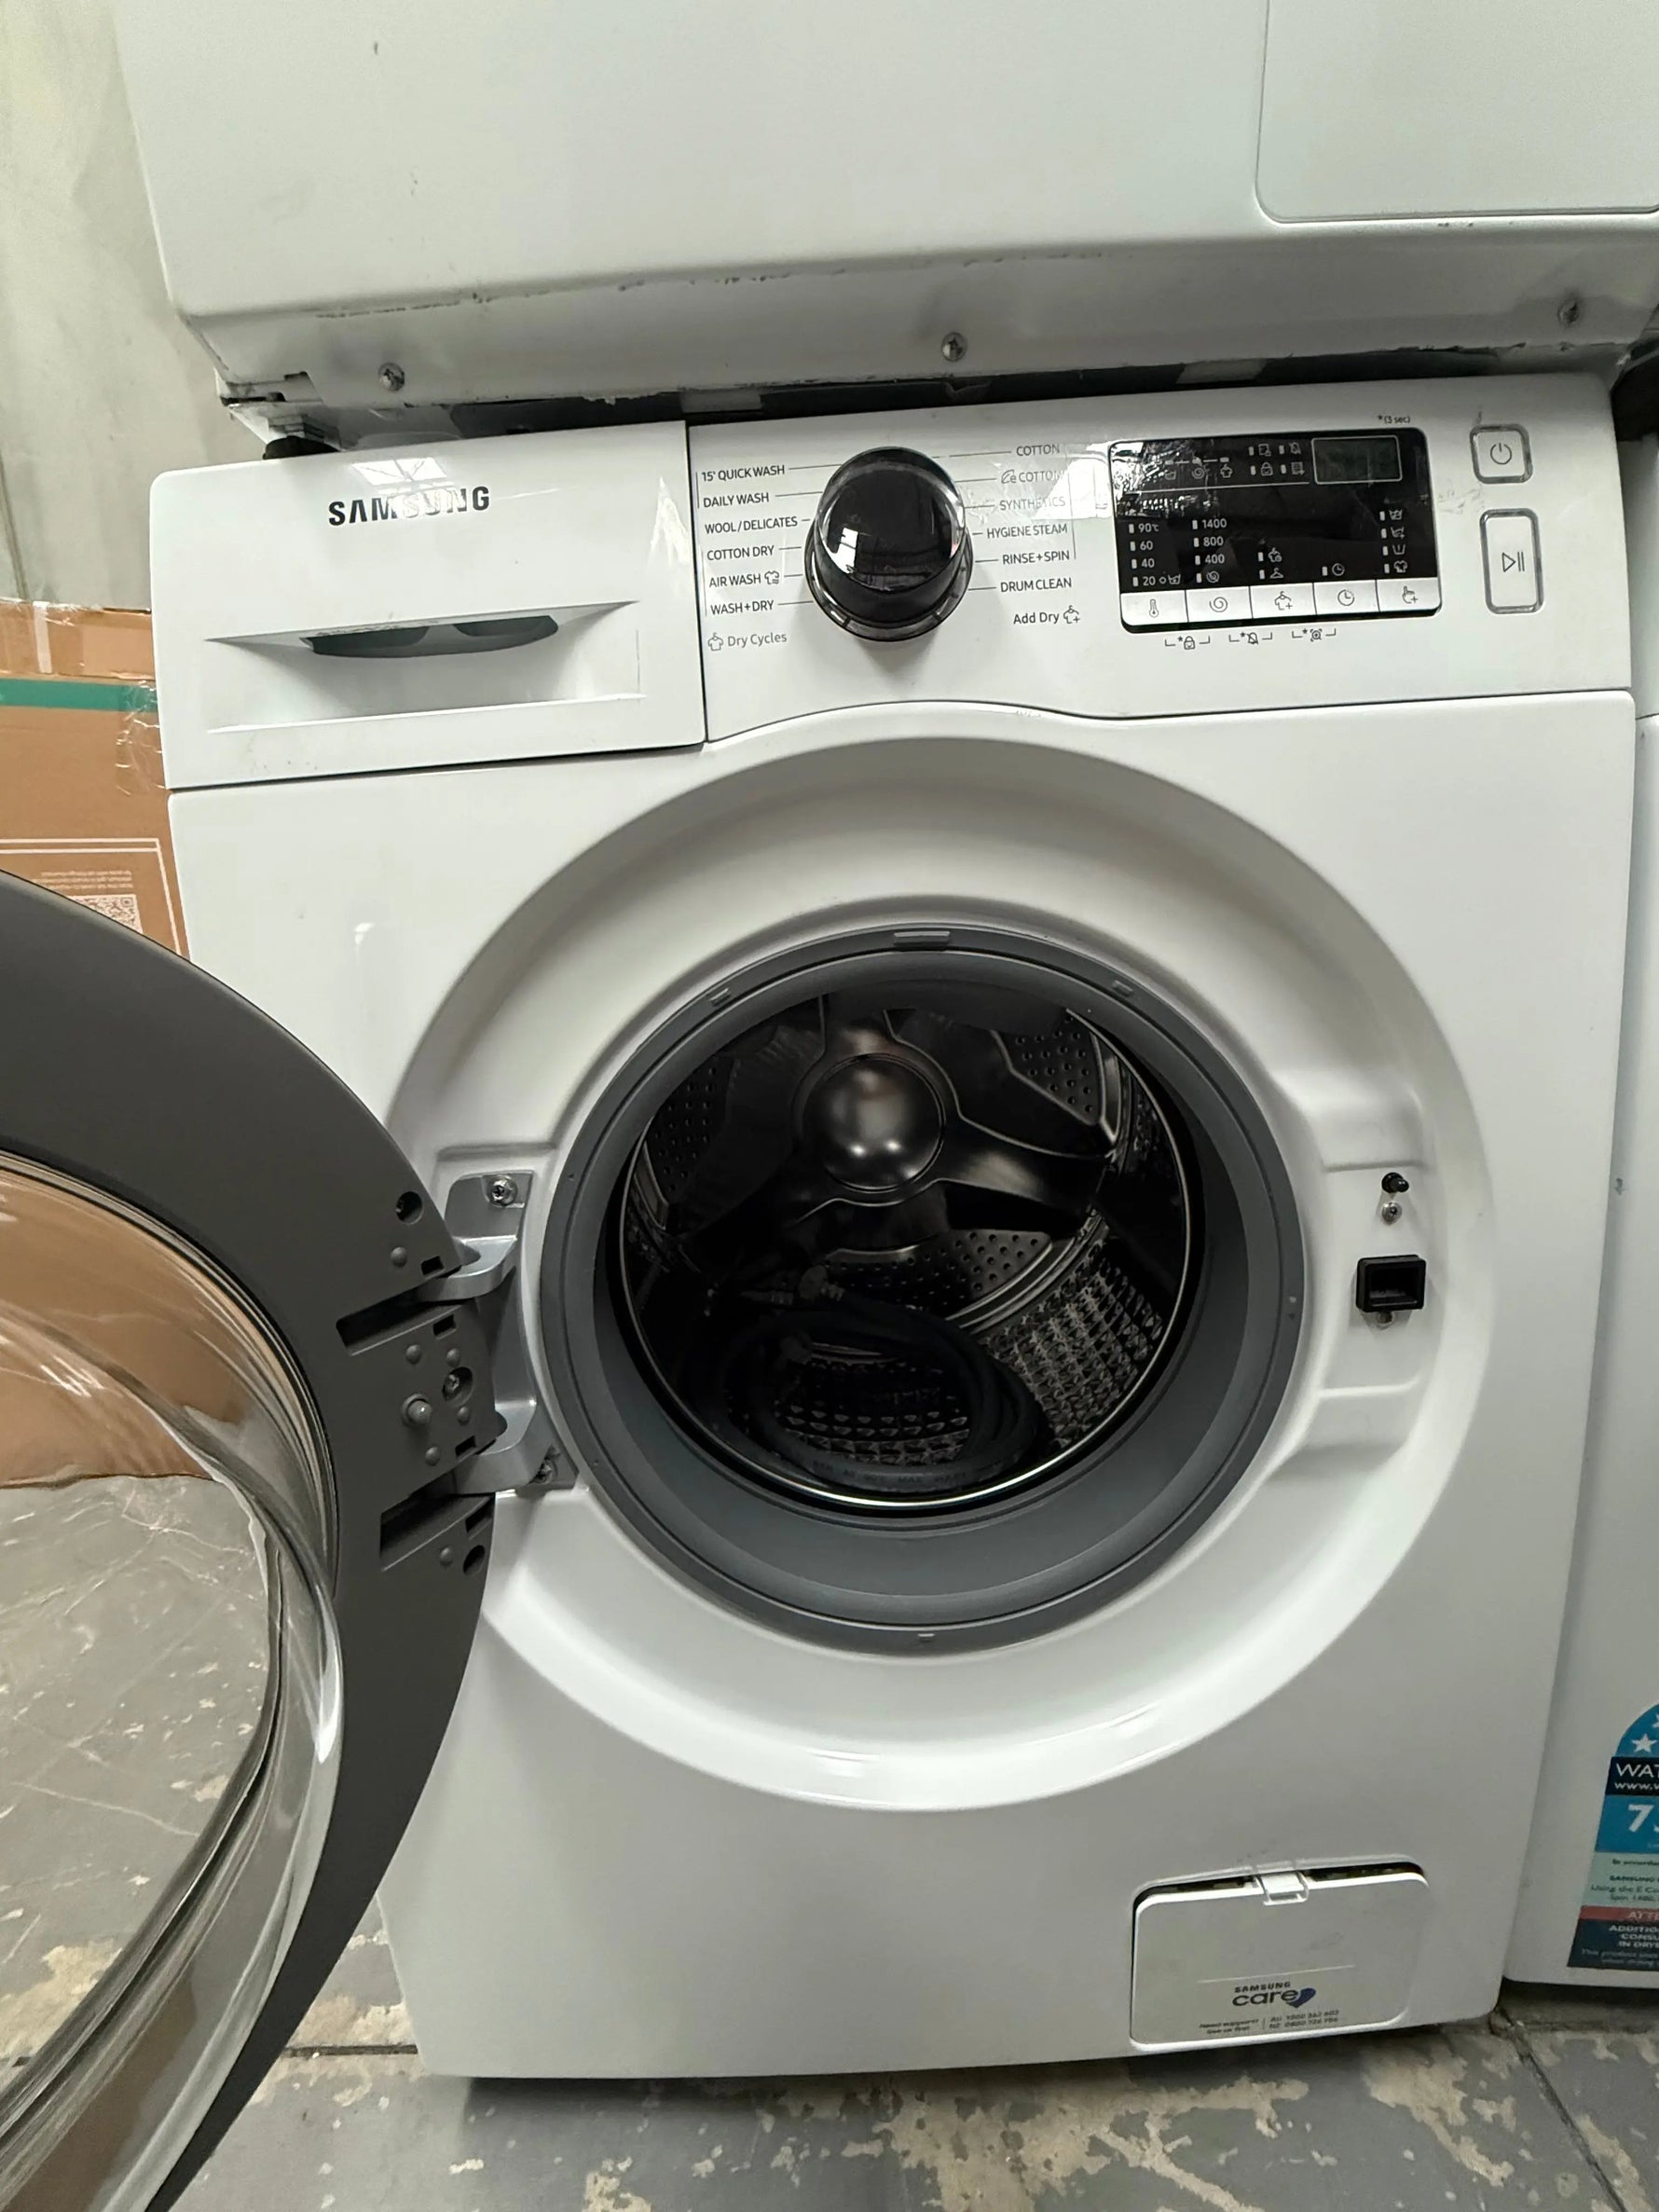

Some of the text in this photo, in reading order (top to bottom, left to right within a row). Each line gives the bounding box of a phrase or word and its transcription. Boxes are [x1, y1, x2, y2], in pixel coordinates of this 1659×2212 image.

[1393, 415, 1411, 424] sec)
[1016, 444, 1060, 457] COTTON
[718, 468, 752, 481] QUICK
[752, 464, 785, 477] WASH
[328, 486, 489, 527] SAMSUNG
[703, 492, 770, 508] DAILY WASH
[999, 496, 1066, 511] SYNTHETICS
[1201, 518, 1227, 529] 1400
[986, 523, 1068, 539] HYGIENE STEAM
[1140, 541, 1154, 551] 60
[1203, 536, 1224, 547] 800
[706, 545, 775, 560] COTTON DRY
[1204, 554, 1226, 565] 400
[1141, 558, 1155, 569] 40
[709, 573, 761, 588] AIR WASH
[1000, 577, 1073, 593] DRUM CLEAN
[1143, 576, 1156, 586] 20
[1013, 611, 1060, 625] Add Dry
[727, 632, 788, 649] Dry Cycles
[1627, 1803, 1659, 1834] 7
[1609, 1924, 1659, 1932] ADDITIO
[1234, 1981, 1291, 1993] SAMSUNG
[1232, 1989, 1299, 2007] care
